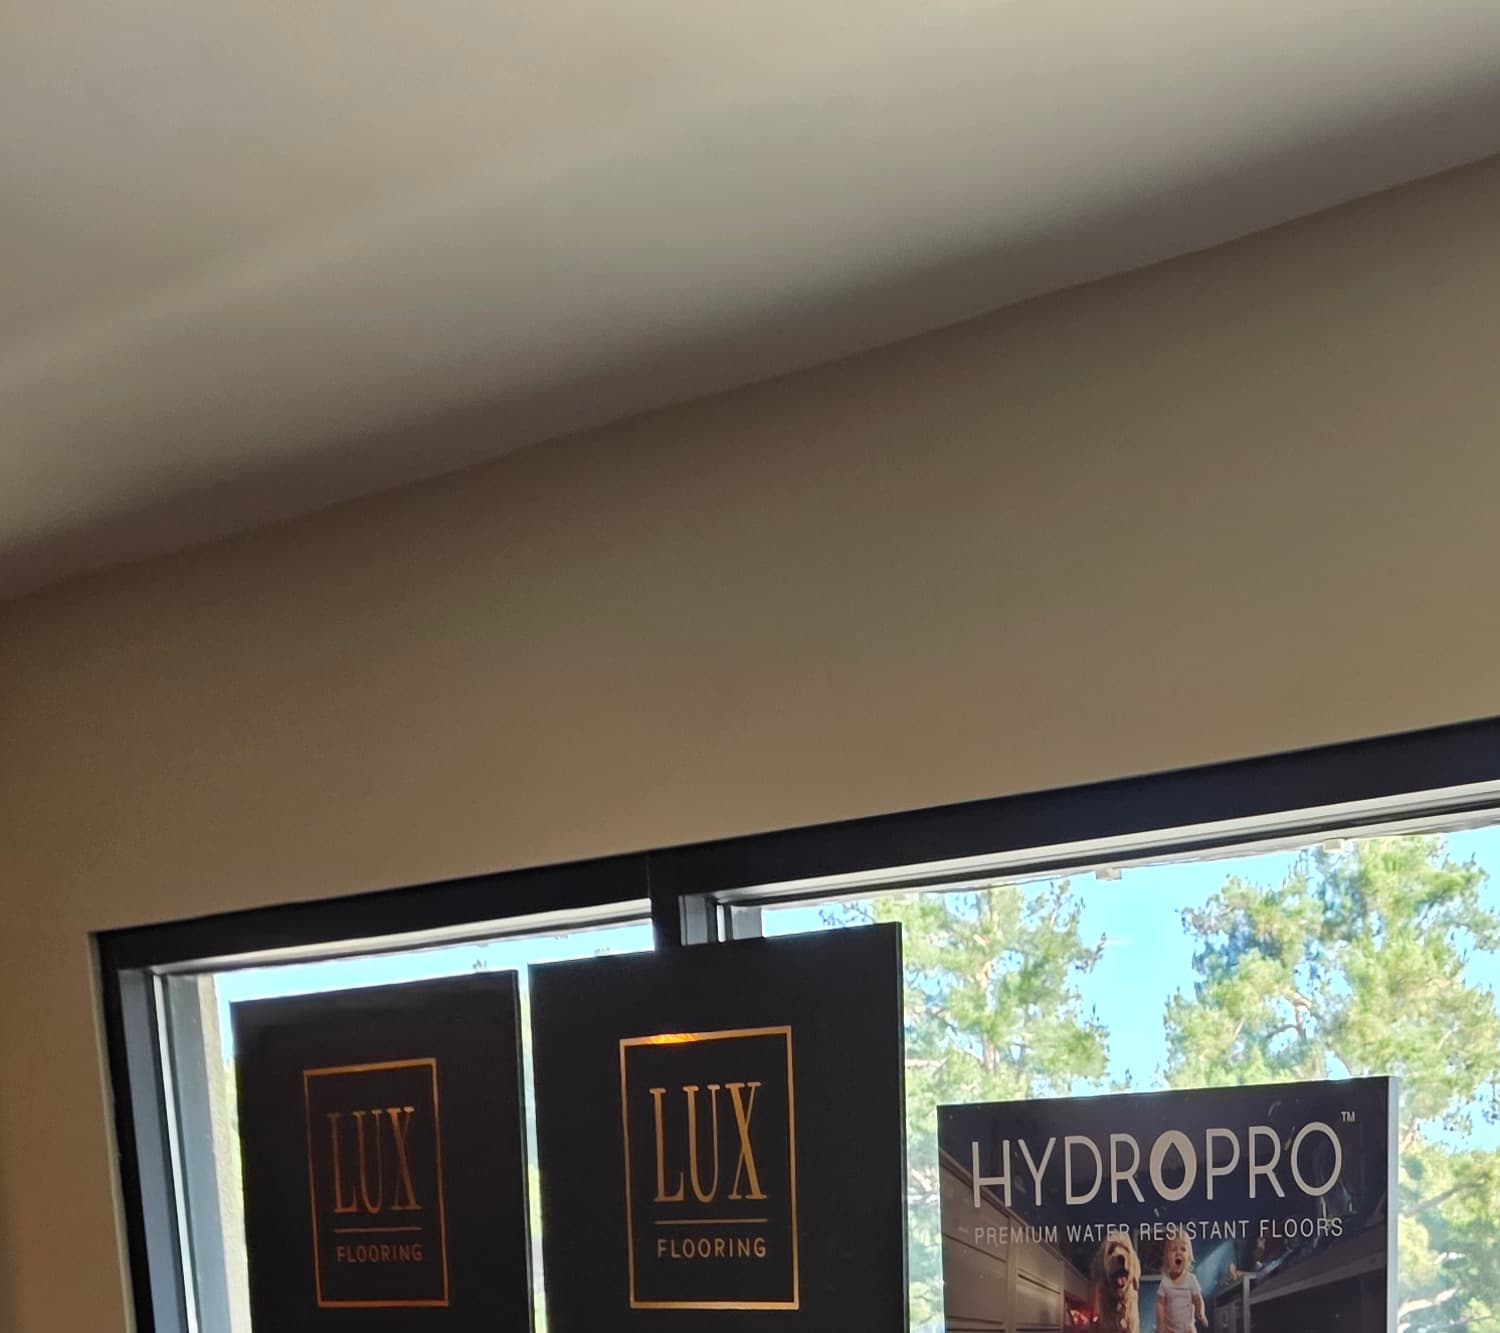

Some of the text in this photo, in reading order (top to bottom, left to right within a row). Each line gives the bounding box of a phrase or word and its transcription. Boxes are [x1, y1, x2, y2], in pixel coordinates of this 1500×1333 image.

[326, 1106, 422, 1215] LUX
[649, 1081, 768, 1203] LUX
[970, 1120, 1343, 1208] HYDROPRO
[336, 1242, 423, 1264] FLOORING
[656, 1236, 767, 1260] FLOORING
[974, 1217, 1343, 1246] PREMIUM WATER RESISTANT FLOORS
